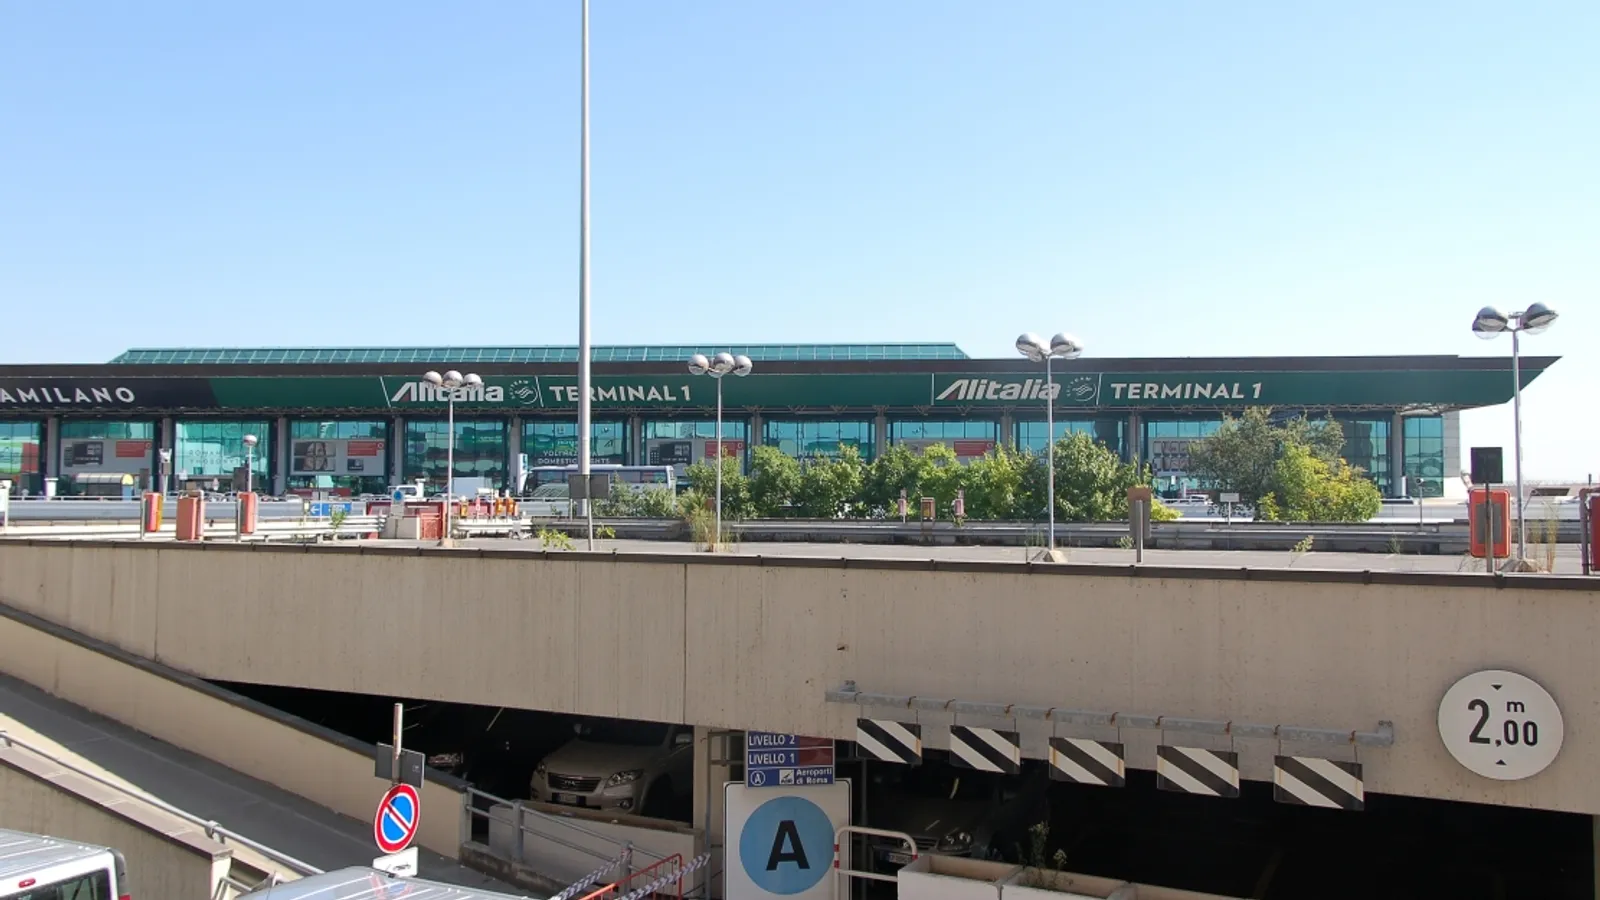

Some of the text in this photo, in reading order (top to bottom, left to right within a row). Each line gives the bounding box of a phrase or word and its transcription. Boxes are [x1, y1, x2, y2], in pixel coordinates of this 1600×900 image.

[0, 387, 135, 402] AMILANO
[681, 385, 690, 401] 1
[935, 379, 1061, 400] Alitalia
[1111, 382, 1262, 399] TERMINAL 1
[1506, 701, 1525, 713] m
[748, 734, 795, 746] LIVELLO 2
[748, 753, 795, 765] LIVELLO 1
[796, 768, 832, 777] Aeroporti
[796, 776, 803, 784] di
[806, 776, 828, 784] Roma
[766, 820, 810, 871] A
